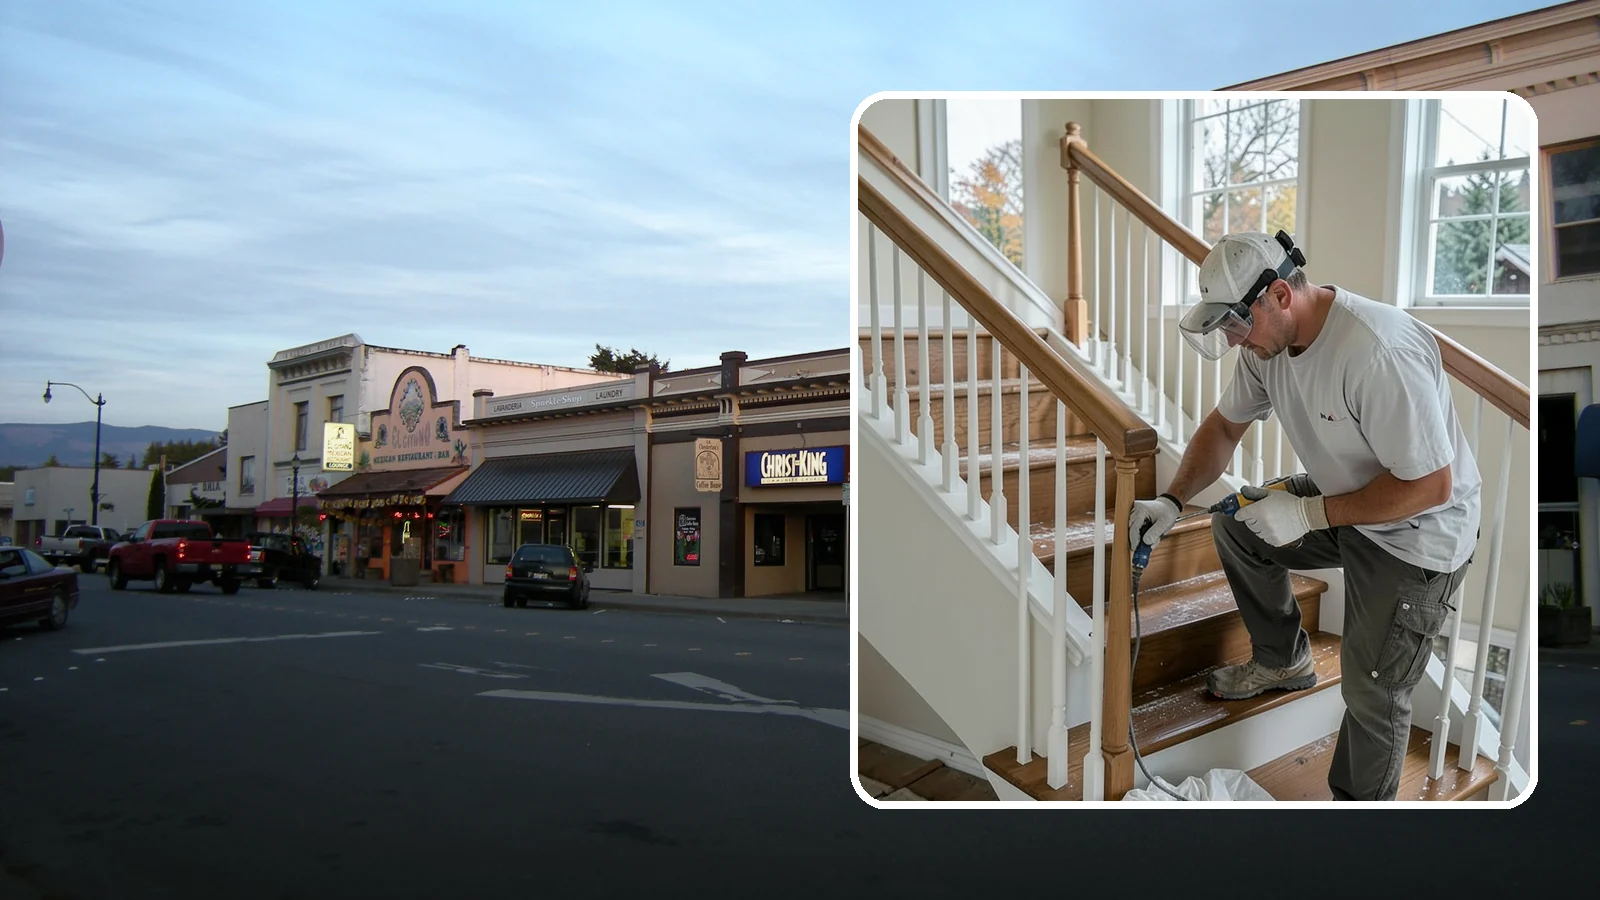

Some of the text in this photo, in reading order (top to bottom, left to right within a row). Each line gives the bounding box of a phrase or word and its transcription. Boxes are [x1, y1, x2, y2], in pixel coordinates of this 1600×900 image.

[494, 389, 623, 412] LAVANDERIA Sparkle Shop LAUNDRY
[374, 450, 450, 464] MEXICAN RESTAURANT BAR
[761, 450, 827, 478] CHRIST KING
